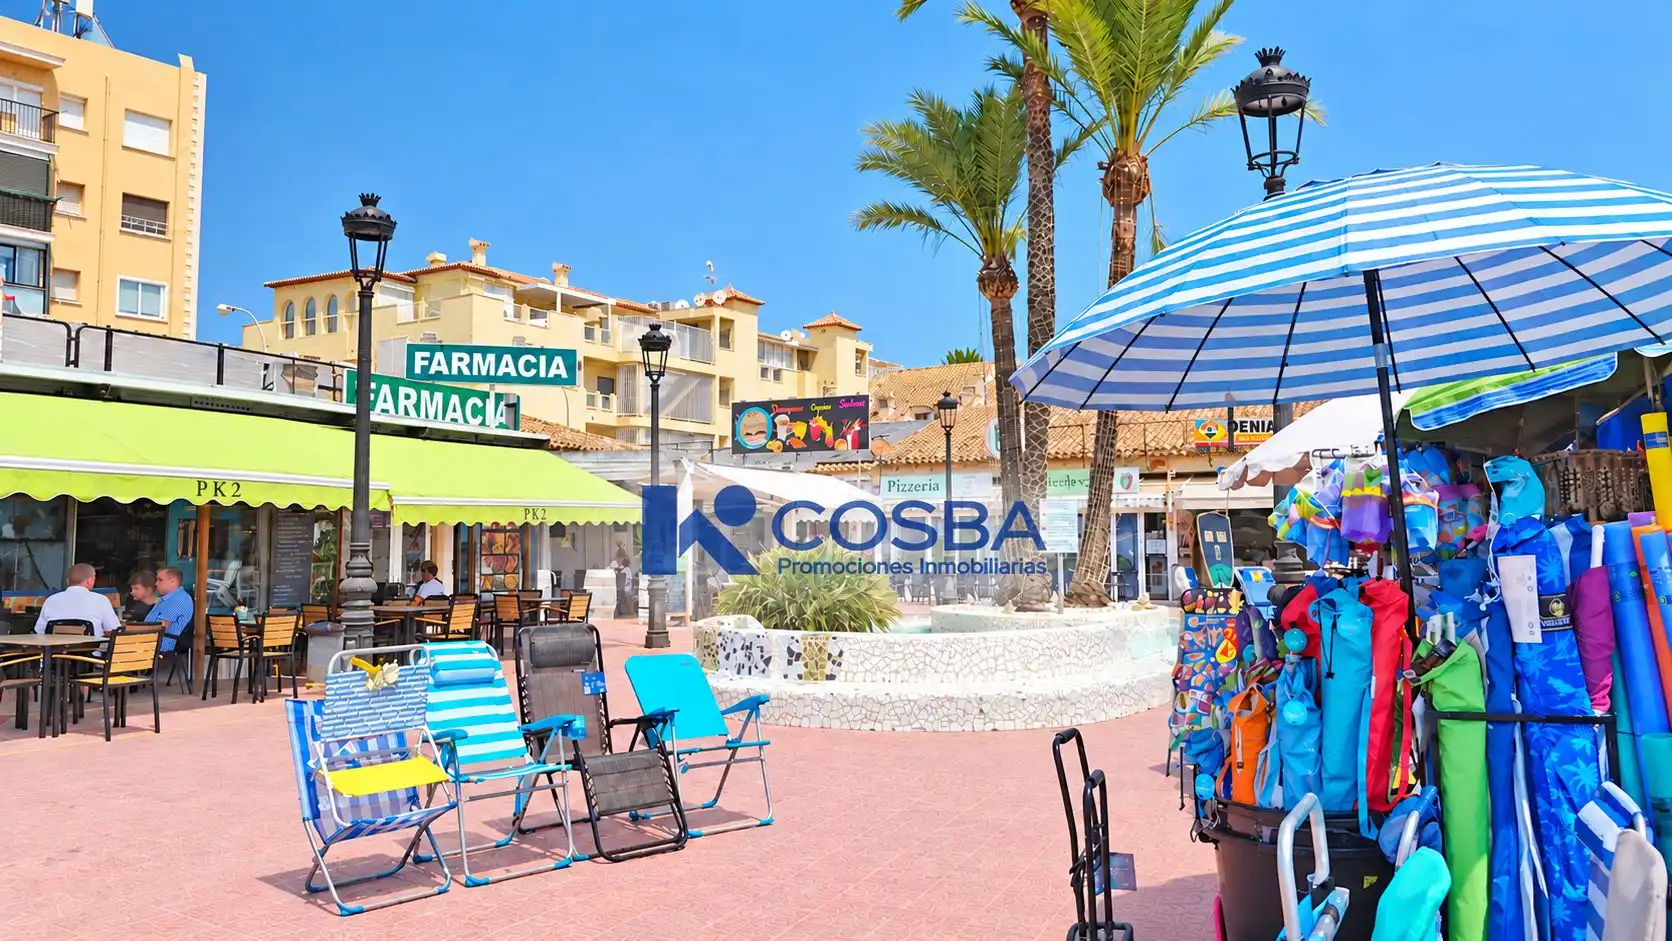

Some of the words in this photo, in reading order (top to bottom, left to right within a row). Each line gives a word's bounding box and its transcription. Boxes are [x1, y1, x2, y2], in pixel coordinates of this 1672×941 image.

[414, 352, 568, 379] FARMACIA
[1229, 420, 1275, 433] DENIA
[887, 478, 940, 493] Pizzeria
[524, 508, 547, 520] PK2
